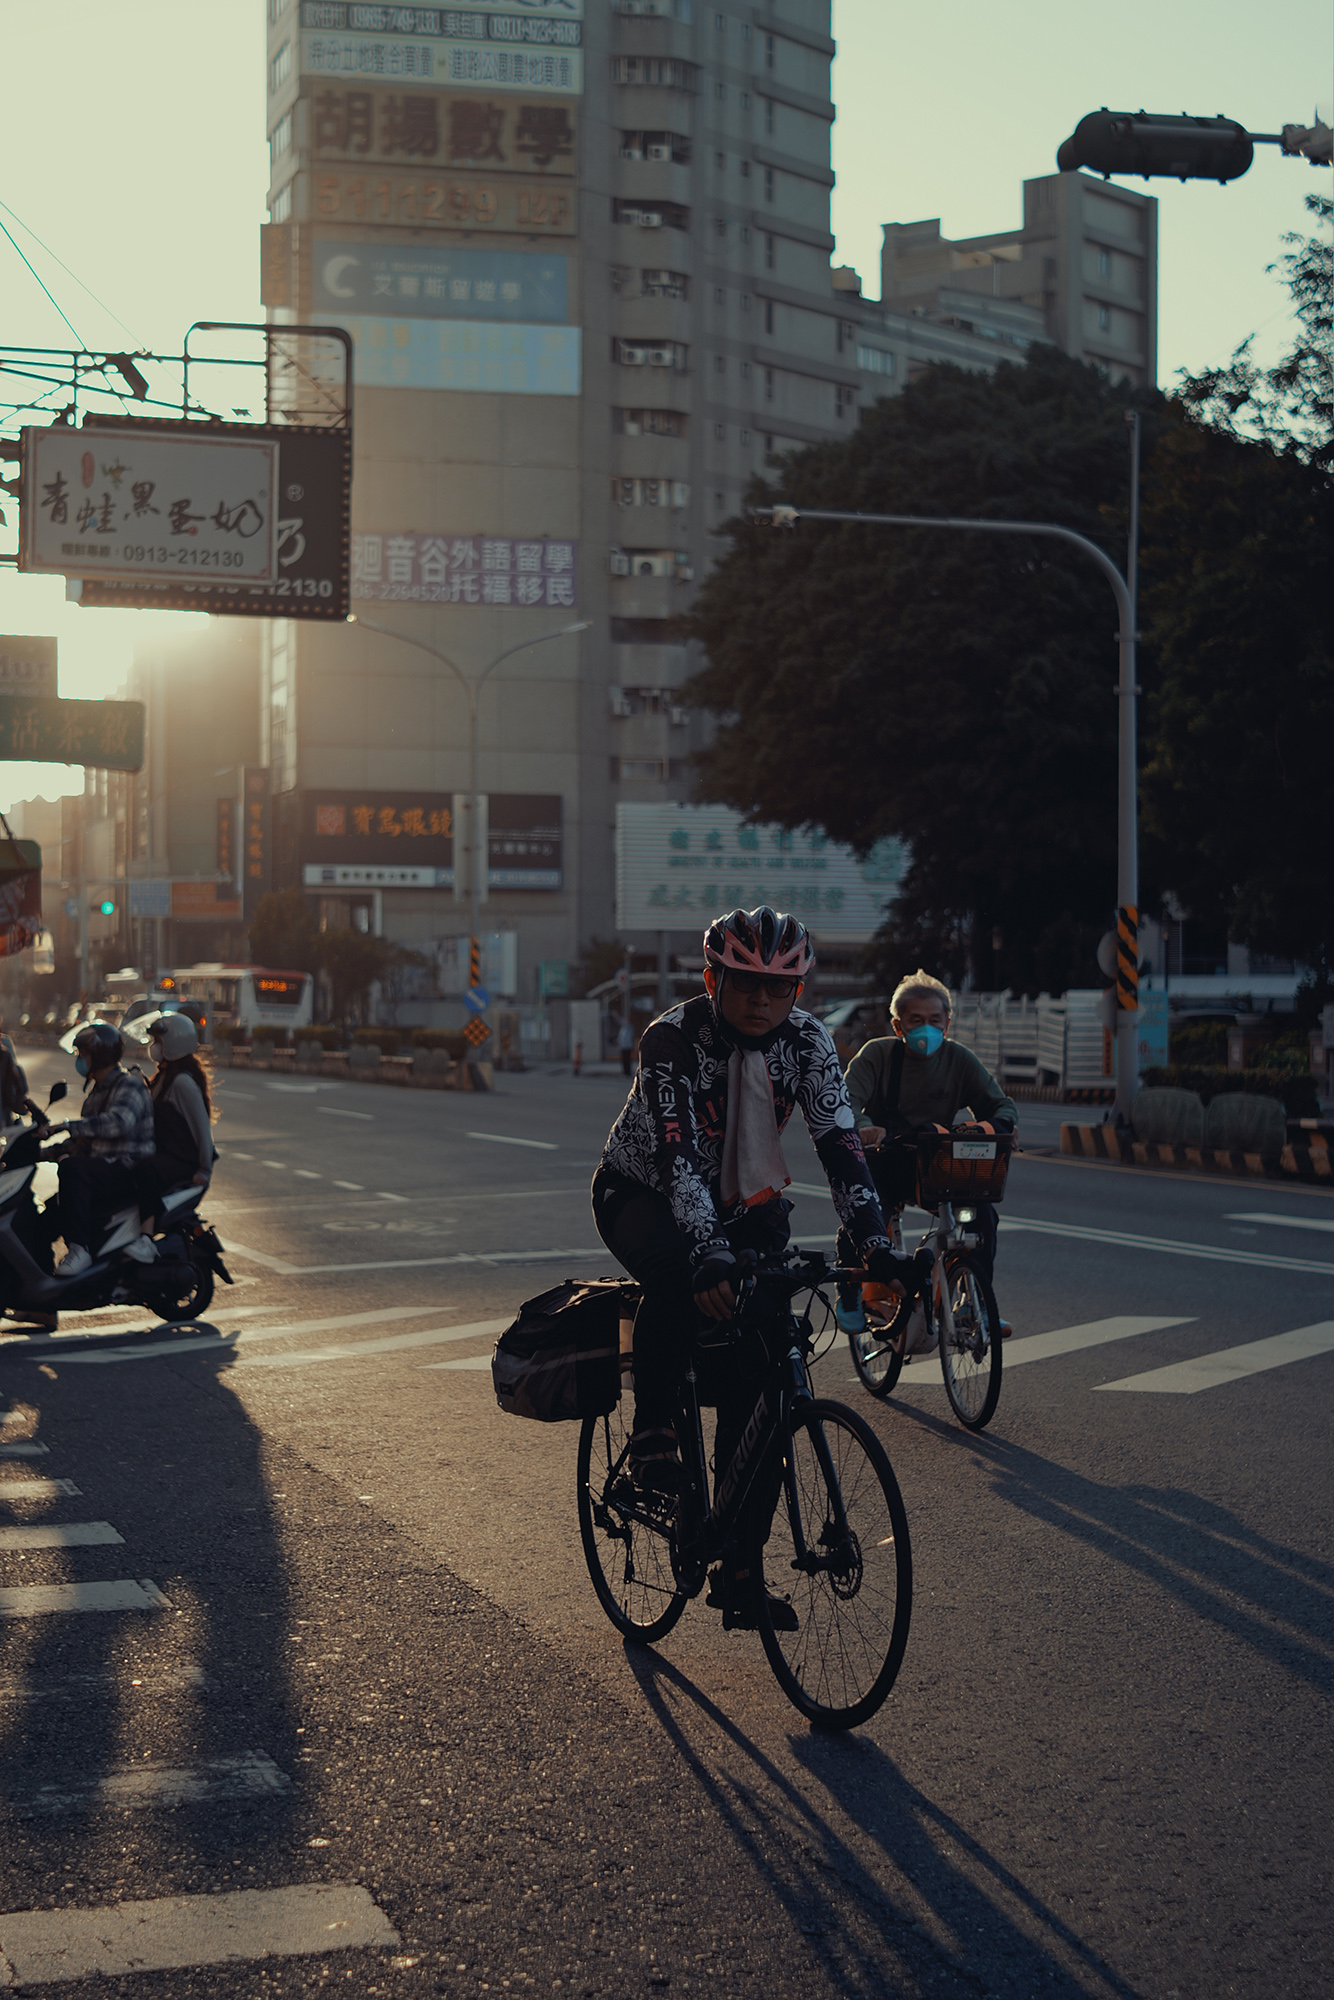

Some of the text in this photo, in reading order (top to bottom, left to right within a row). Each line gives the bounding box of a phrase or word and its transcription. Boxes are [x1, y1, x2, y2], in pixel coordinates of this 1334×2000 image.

[123, 544, 244, 568] 0913-212130
[449, 538, 575, 574] 外語留學
[450, 573, 576, 607] 托福移民
[351, 804, 454, 839] 寶島眼鏡
[709, 1391, 769, 1531] MERIDA
